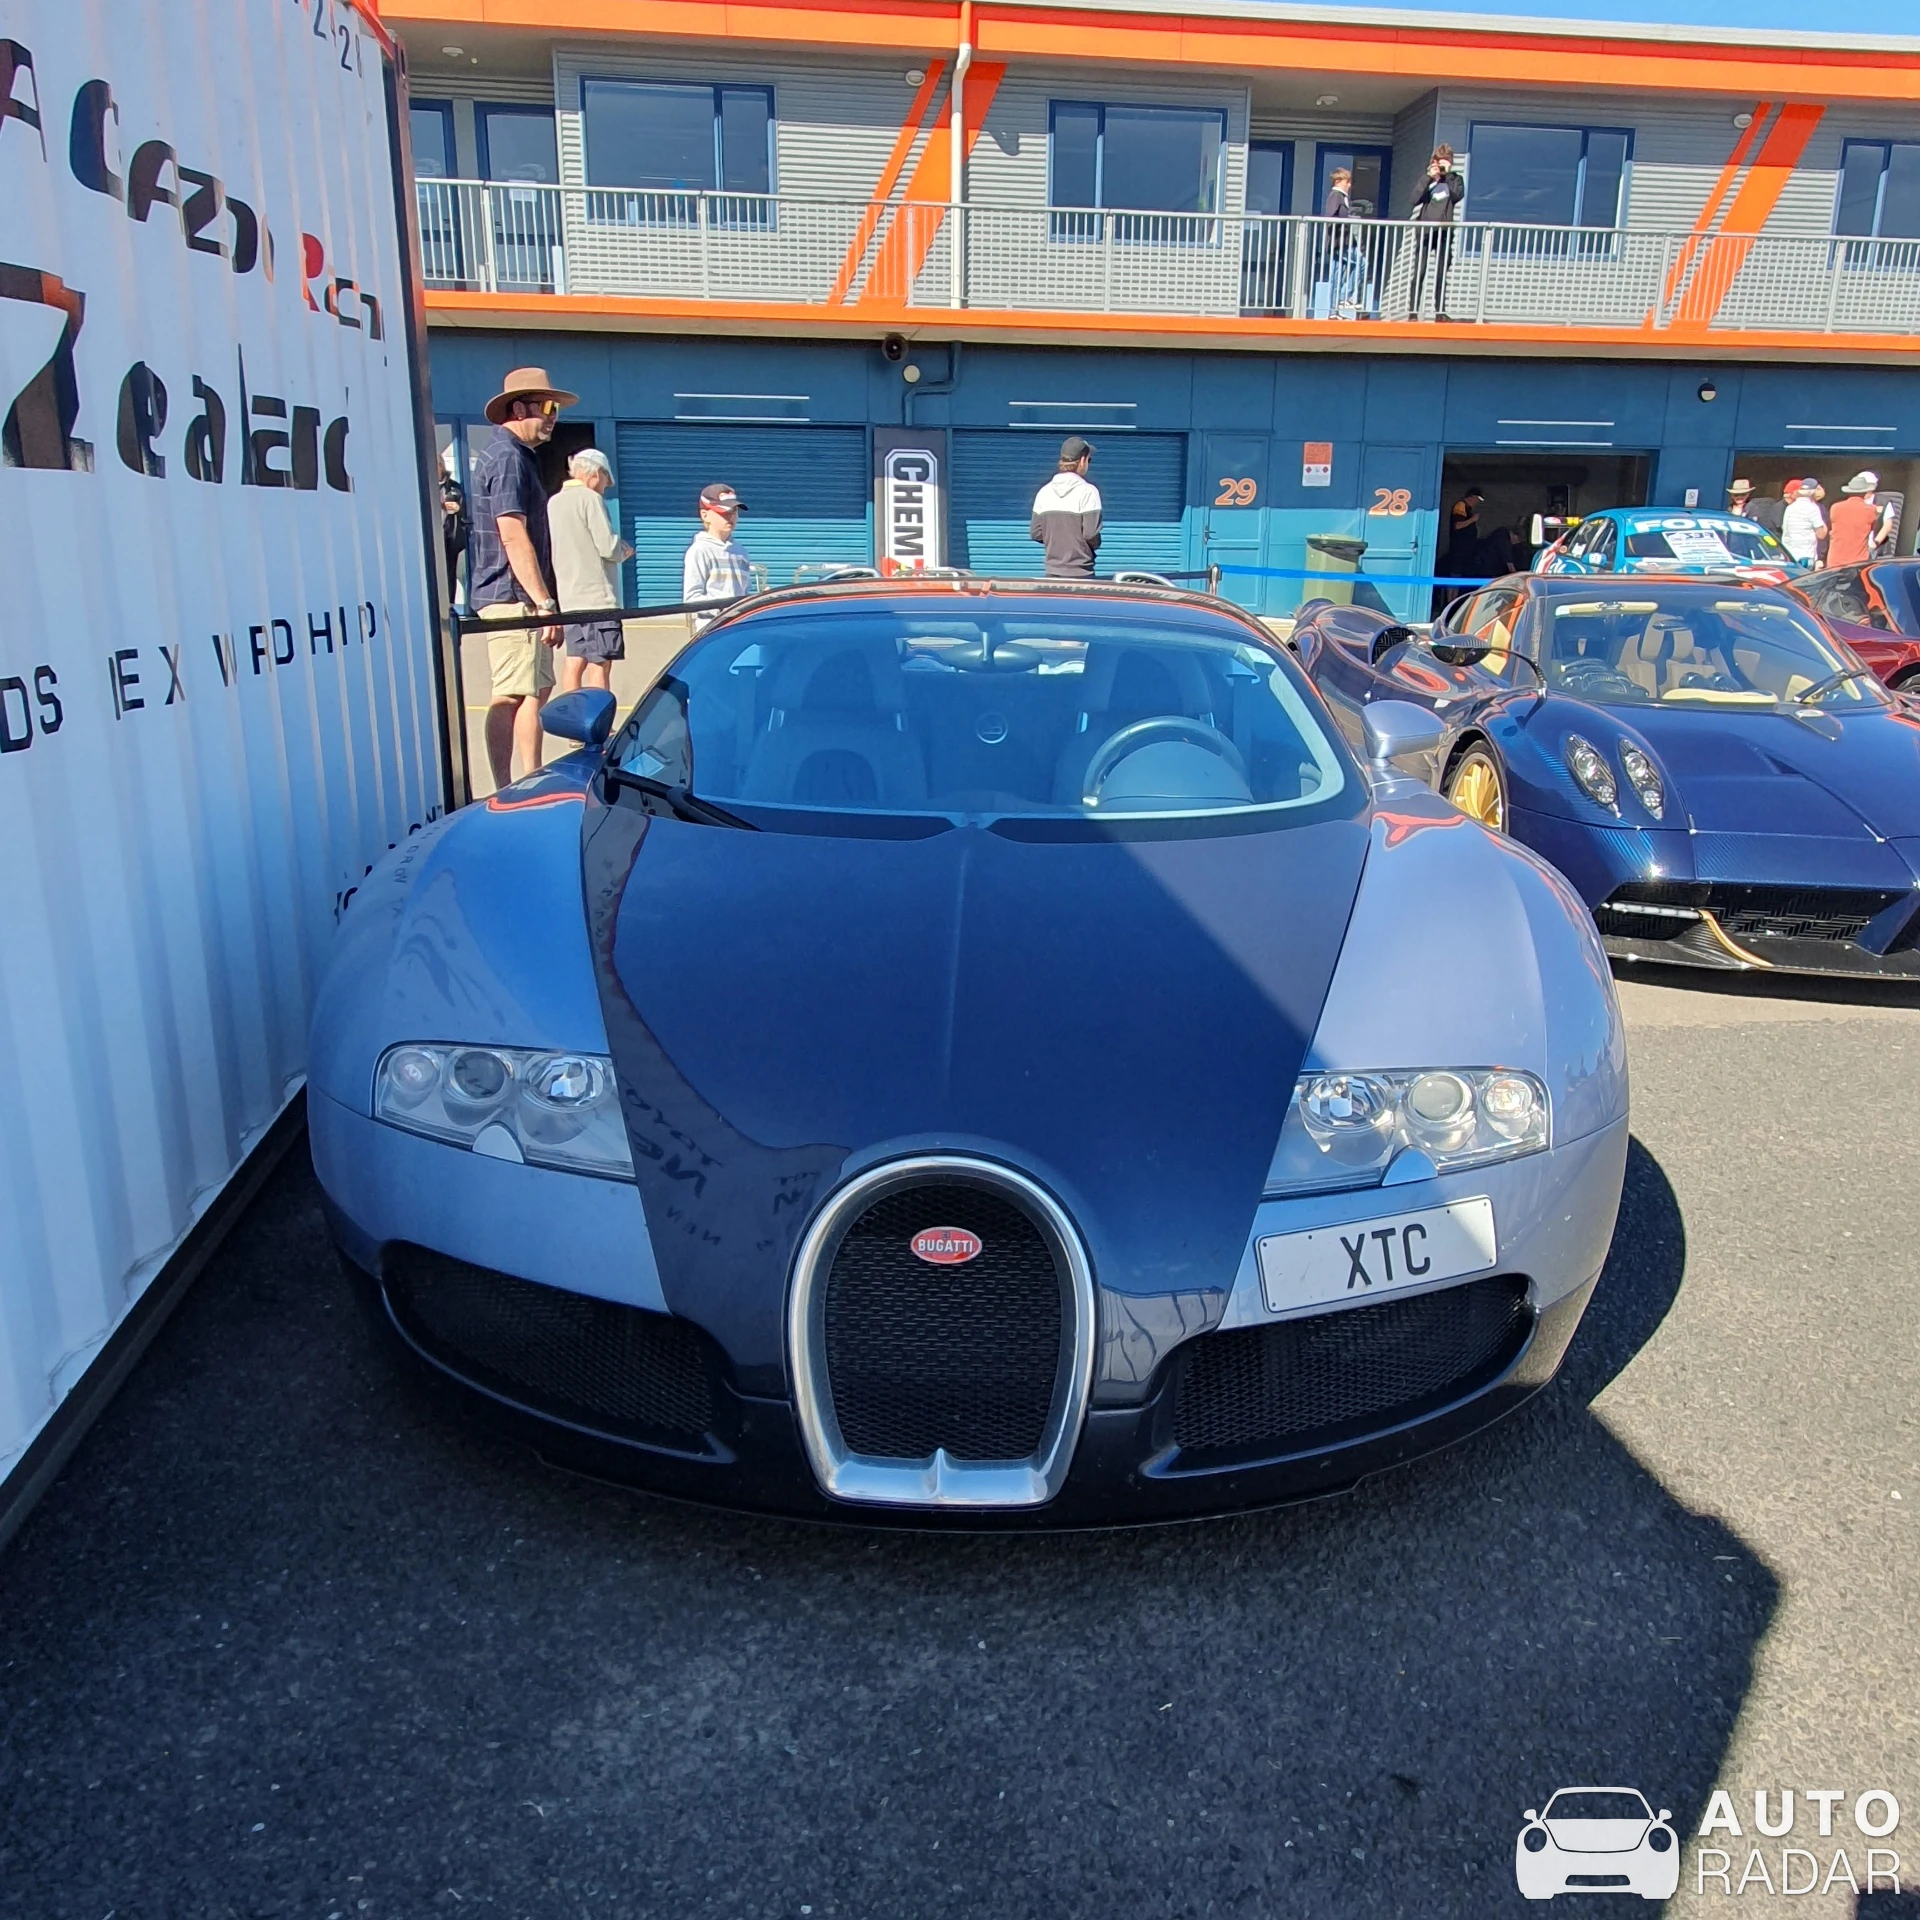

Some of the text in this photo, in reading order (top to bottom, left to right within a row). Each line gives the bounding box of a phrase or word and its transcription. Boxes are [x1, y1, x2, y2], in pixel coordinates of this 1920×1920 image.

[1215, 478, 1257, 506] 29
[1369, 488, 1411, 516] 28
[893, 457, 931, 557] CHEM
[1634, 518, 1760, 534] FORD
[918, 1239, 973, 1253] BUGATTI
[1339, 1223, 1431, 1289] XTC
